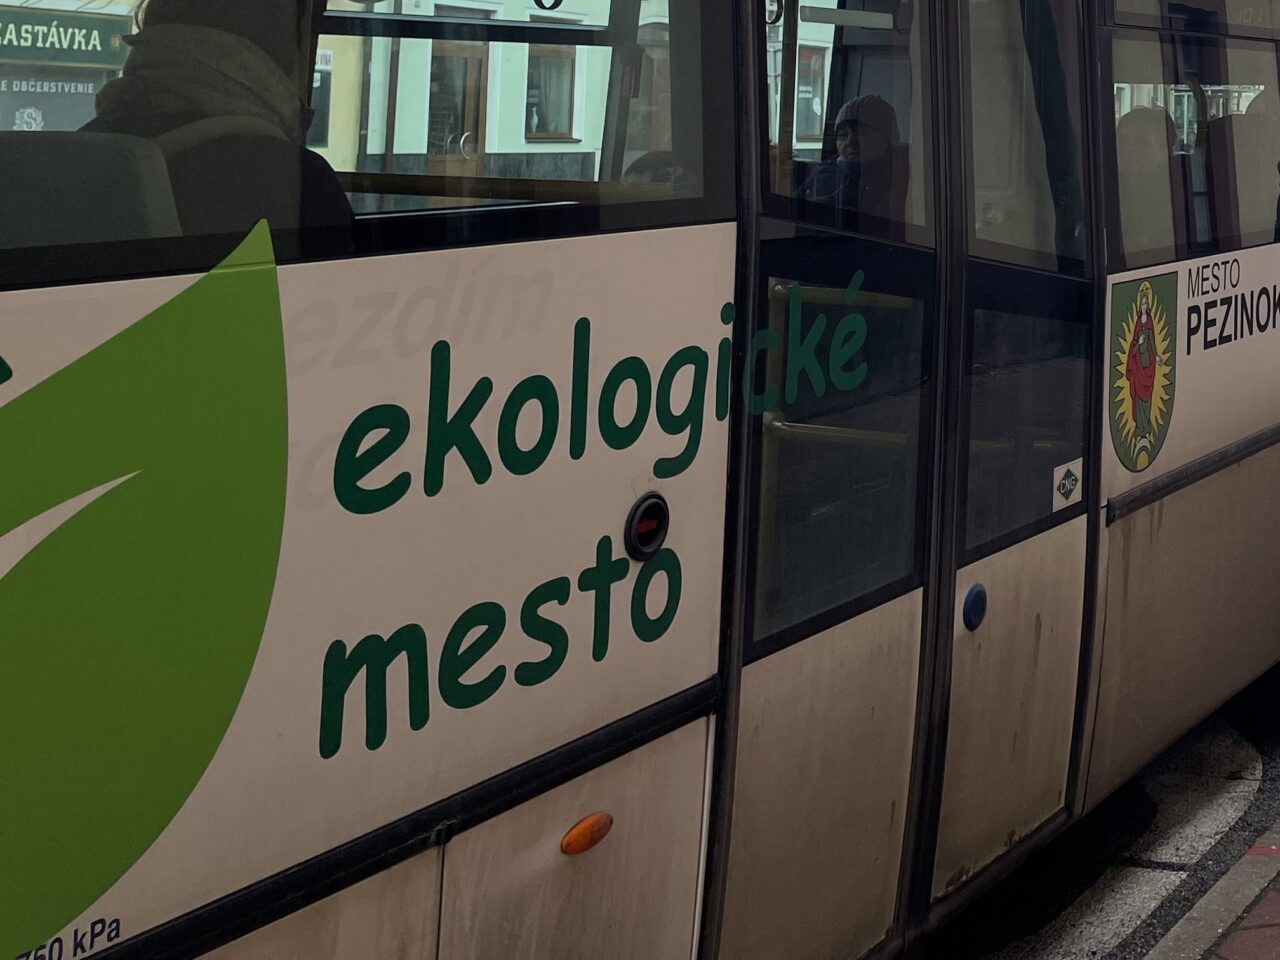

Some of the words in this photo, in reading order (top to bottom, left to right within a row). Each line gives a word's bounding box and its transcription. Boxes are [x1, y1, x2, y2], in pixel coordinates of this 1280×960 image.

[0, 20, 102, 51] ASTÁVKA
[13, 78, 94, 94] OBČERSTVENIE
[1187, 258, 1240, 299] MESTO
[332, 269, 869, 516] ekologické
[1060, 476, 1076, 494] CNG
[318, 534, 683, 759] mesto
[73, 918, 121, 958] kPa
